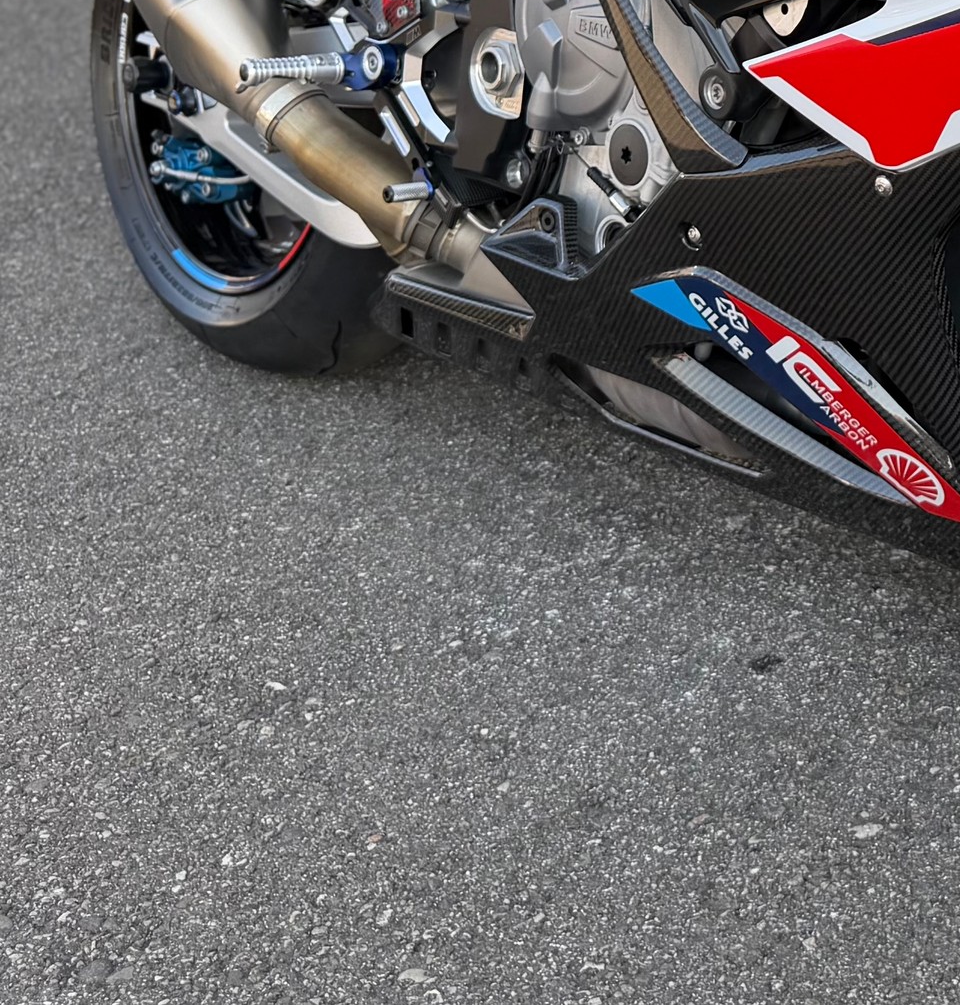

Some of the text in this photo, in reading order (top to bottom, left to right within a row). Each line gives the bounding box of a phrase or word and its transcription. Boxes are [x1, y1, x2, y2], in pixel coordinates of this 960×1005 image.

[579, 18, 613, 39] BMW
[688, 292, 754, 361] GILLES
[798, 366, 879, 446] ILMBERGER
